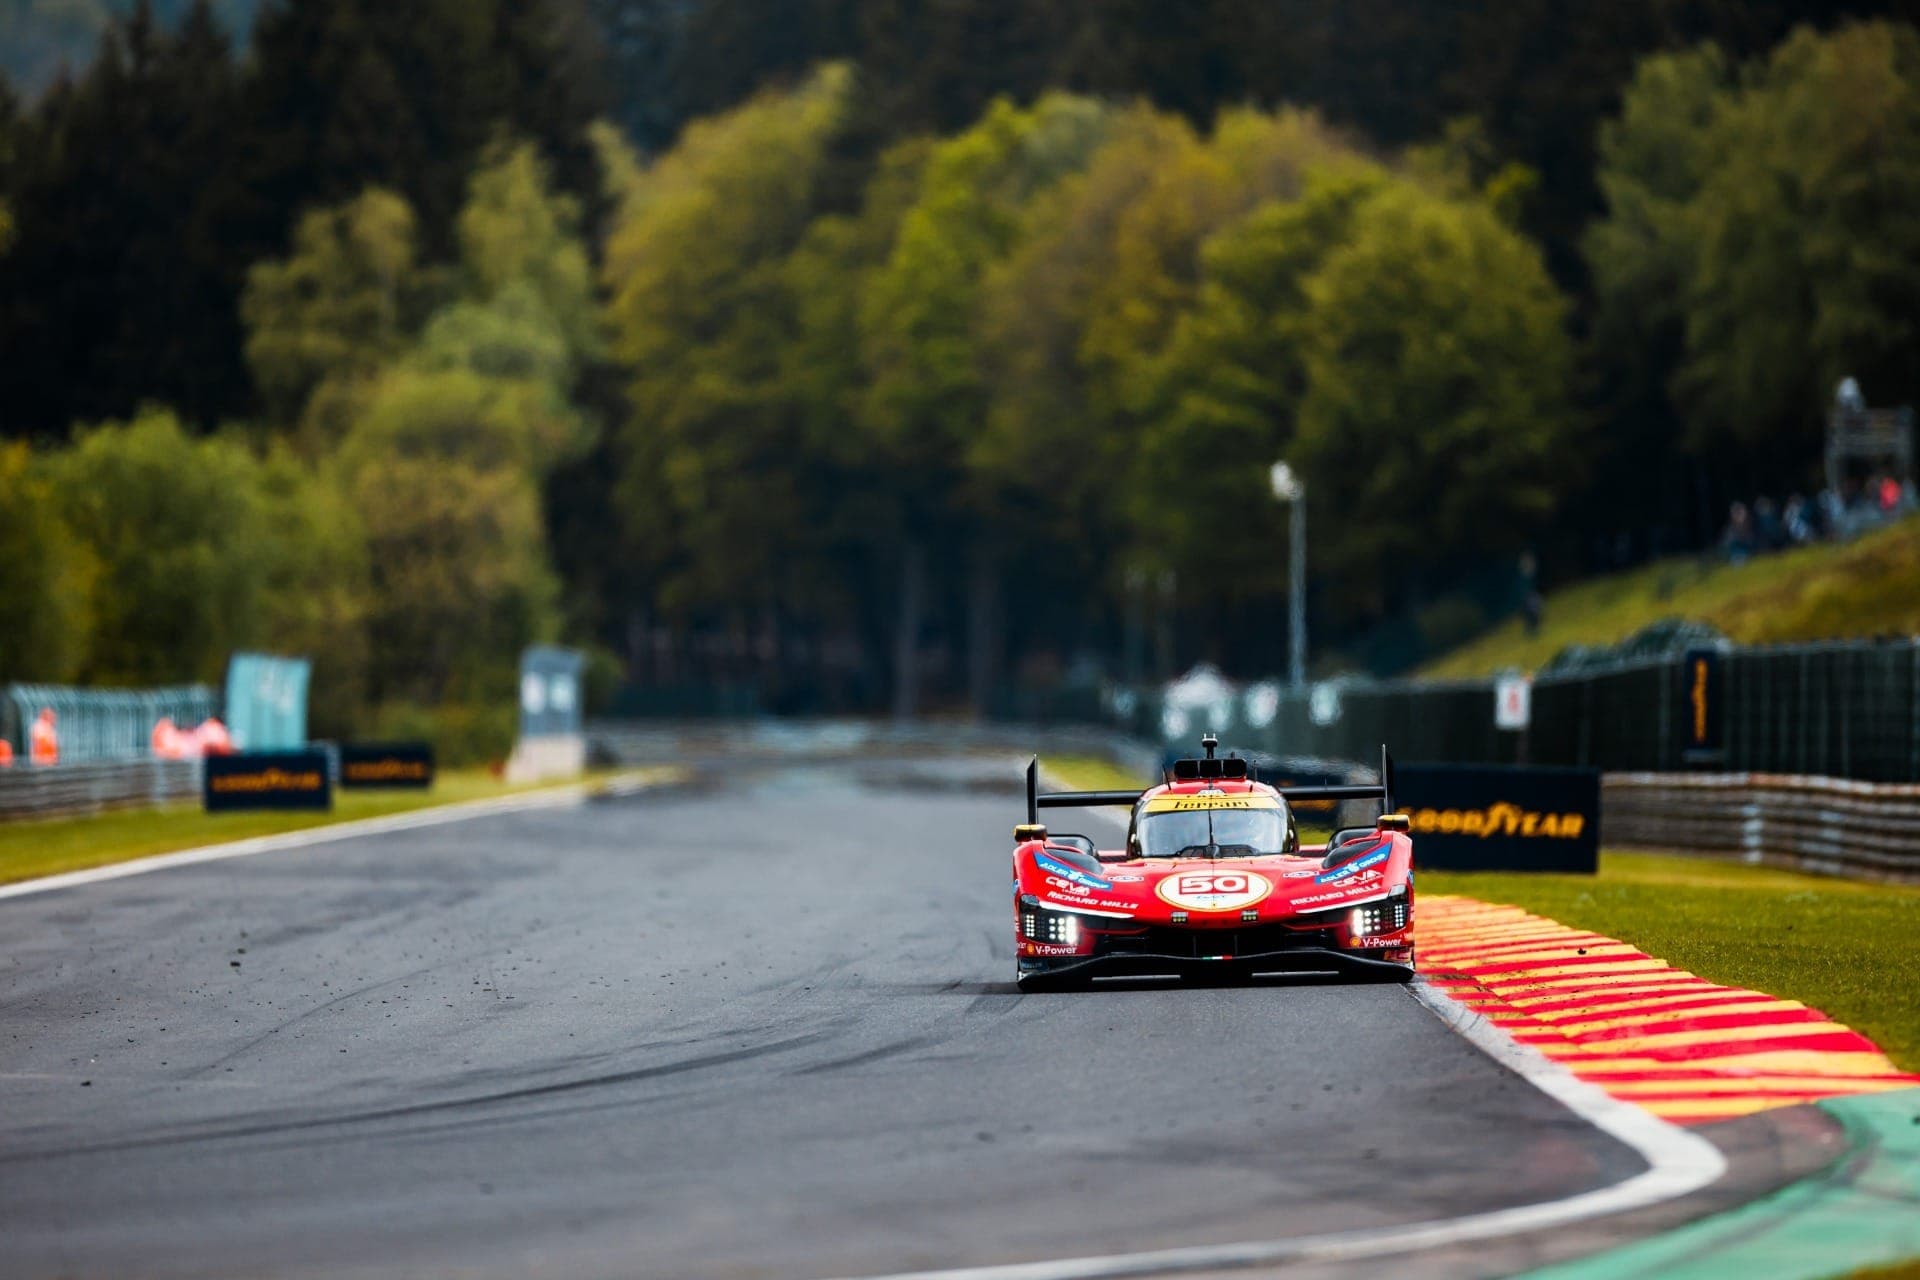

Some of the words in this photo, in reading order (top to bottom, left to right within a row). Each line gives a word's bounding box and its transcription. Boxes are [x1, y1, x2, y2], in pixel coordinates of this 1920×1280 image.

[1174, 800, 1250, 809] Ferrari
[1180, 876, 1246, 893] 50
[1047, 891, 1098, 905] RICHARD
[1100, 899, 1139, 909] MILLE
[1290, 891, 1345, 905] RICHARD
[1345, 883, 1382, 896] MILLE
[1363, 938, 1402, 947] V-Power
[1035, 945, 1078, 955] V-Power
